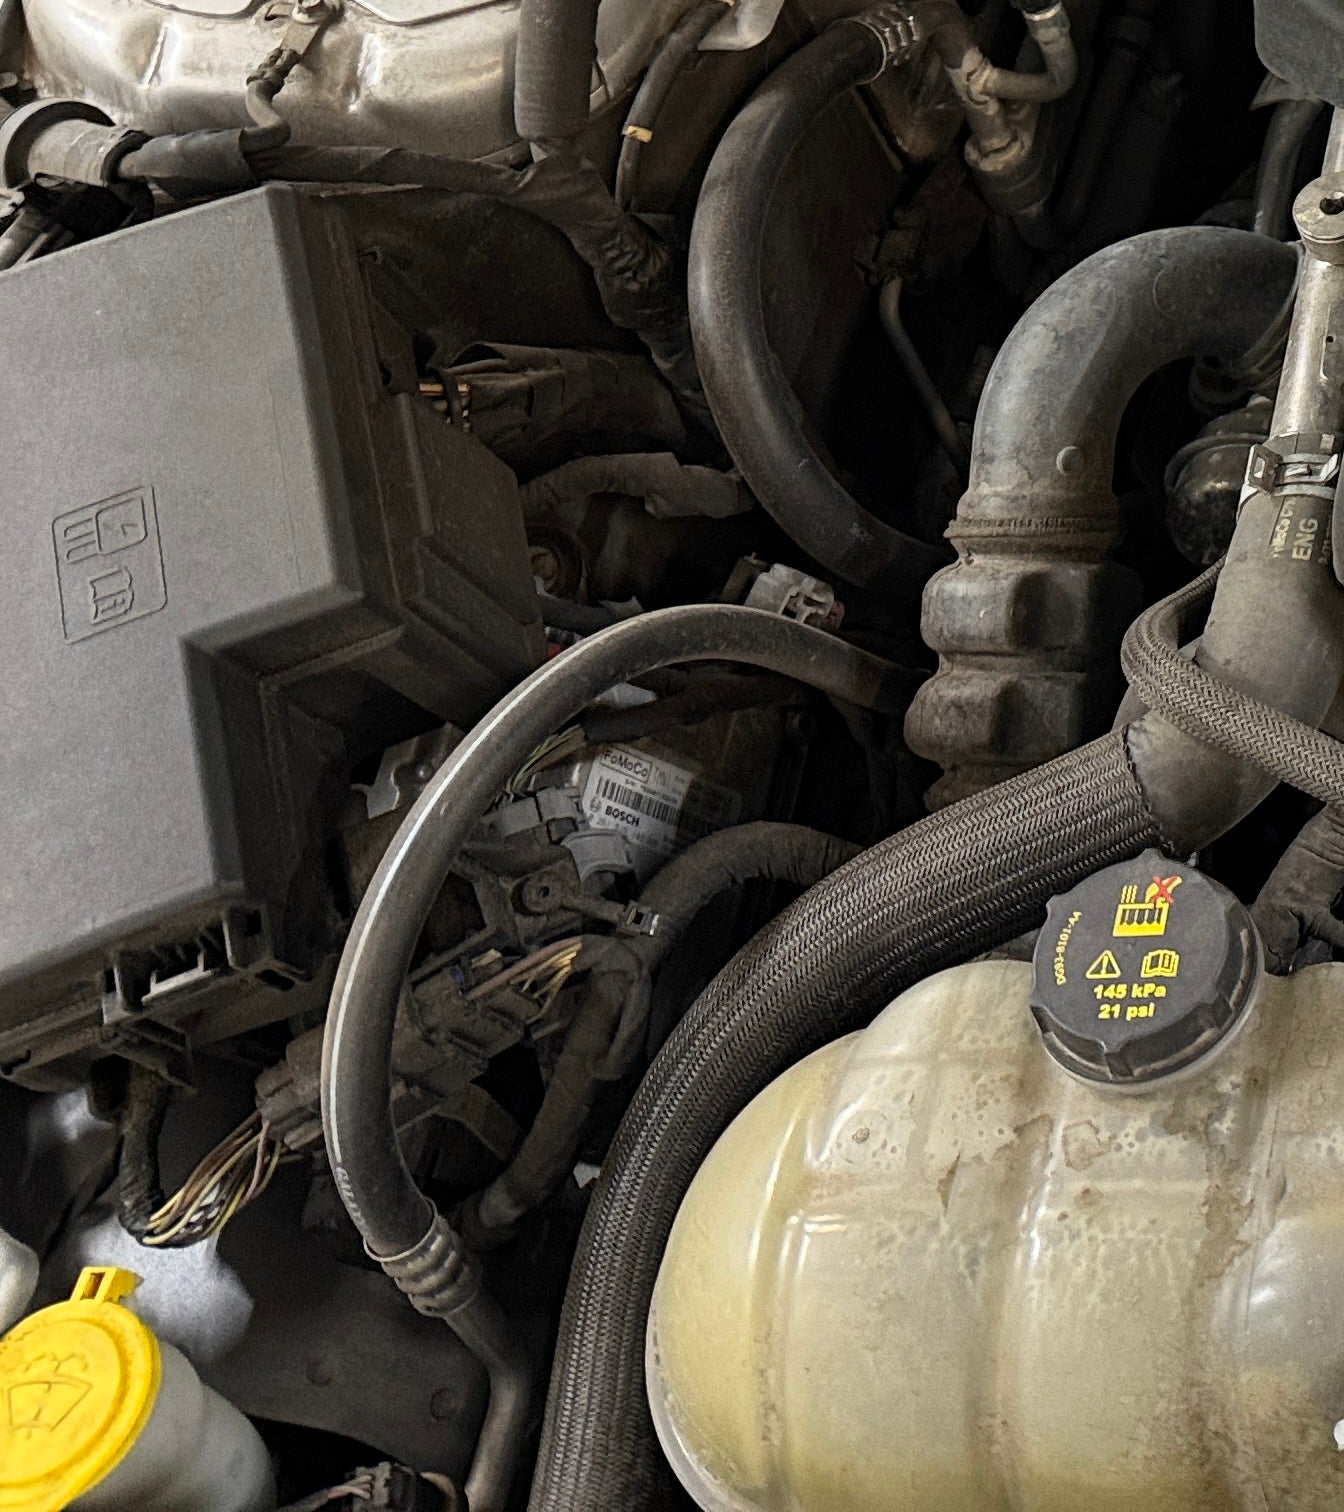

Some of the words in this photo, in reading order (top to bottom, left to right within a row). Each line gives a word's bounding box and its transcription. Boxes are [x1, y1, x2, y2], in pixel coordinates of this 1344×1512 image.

[1290, 517, 1319, 562] ENG
[604, 750, 648, 776] FoMoCo
[604, 804, 641, 828] BOSCH
[1093, 983, 1129, 1000] 145
[1131, 983, 1167, 998] kPa
[1097, 1003, 1121, 1020] 21
[1126, 1002, 1155, 1021] psi
